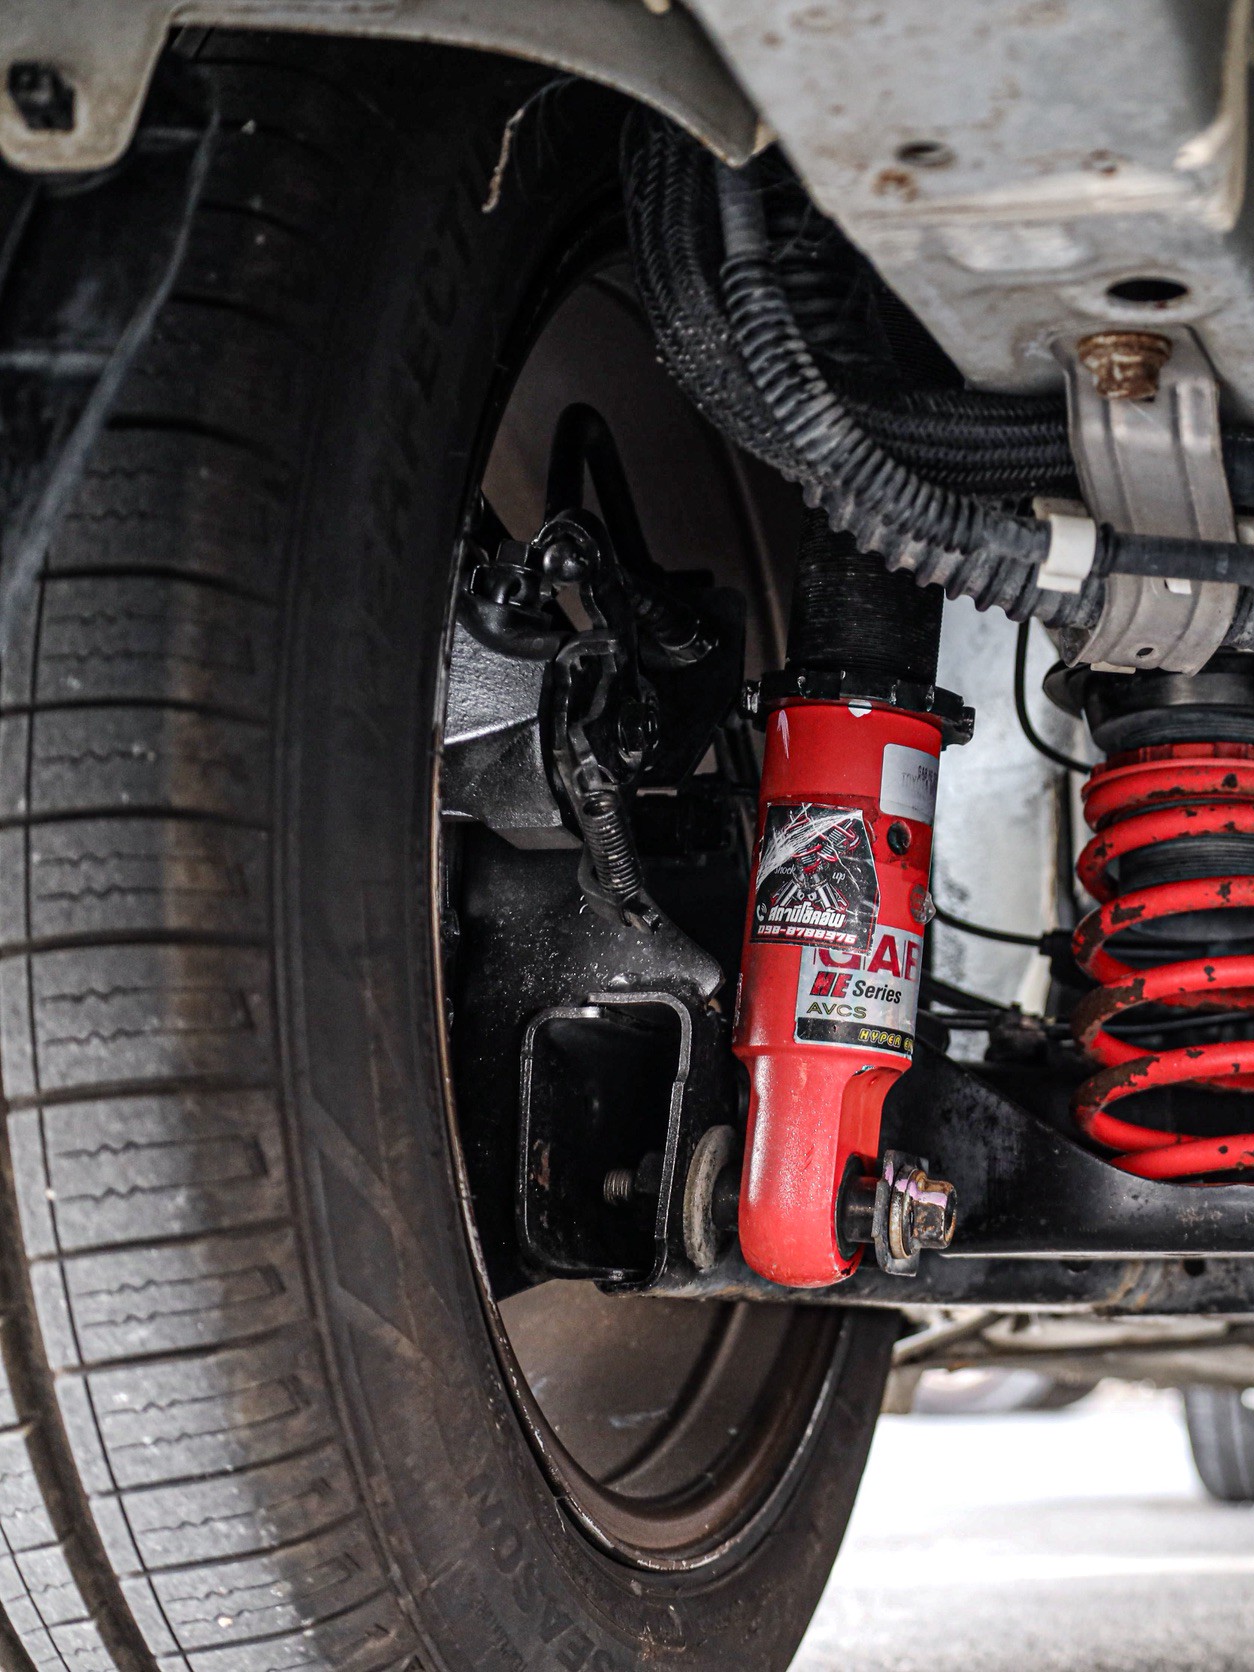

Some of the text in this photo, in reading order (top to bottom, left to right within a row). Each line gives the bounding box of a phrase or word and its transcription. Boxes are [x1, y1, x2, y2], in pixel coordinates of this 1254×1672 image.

[832, 871, 846, 884] up
[757, 925, 858, 944] 098-8788976
[810, 971, 902, 1004] HE Series
[806, 1001, 867, 1019] AVCS
[858, 1028, 902, 1047] HYPER
